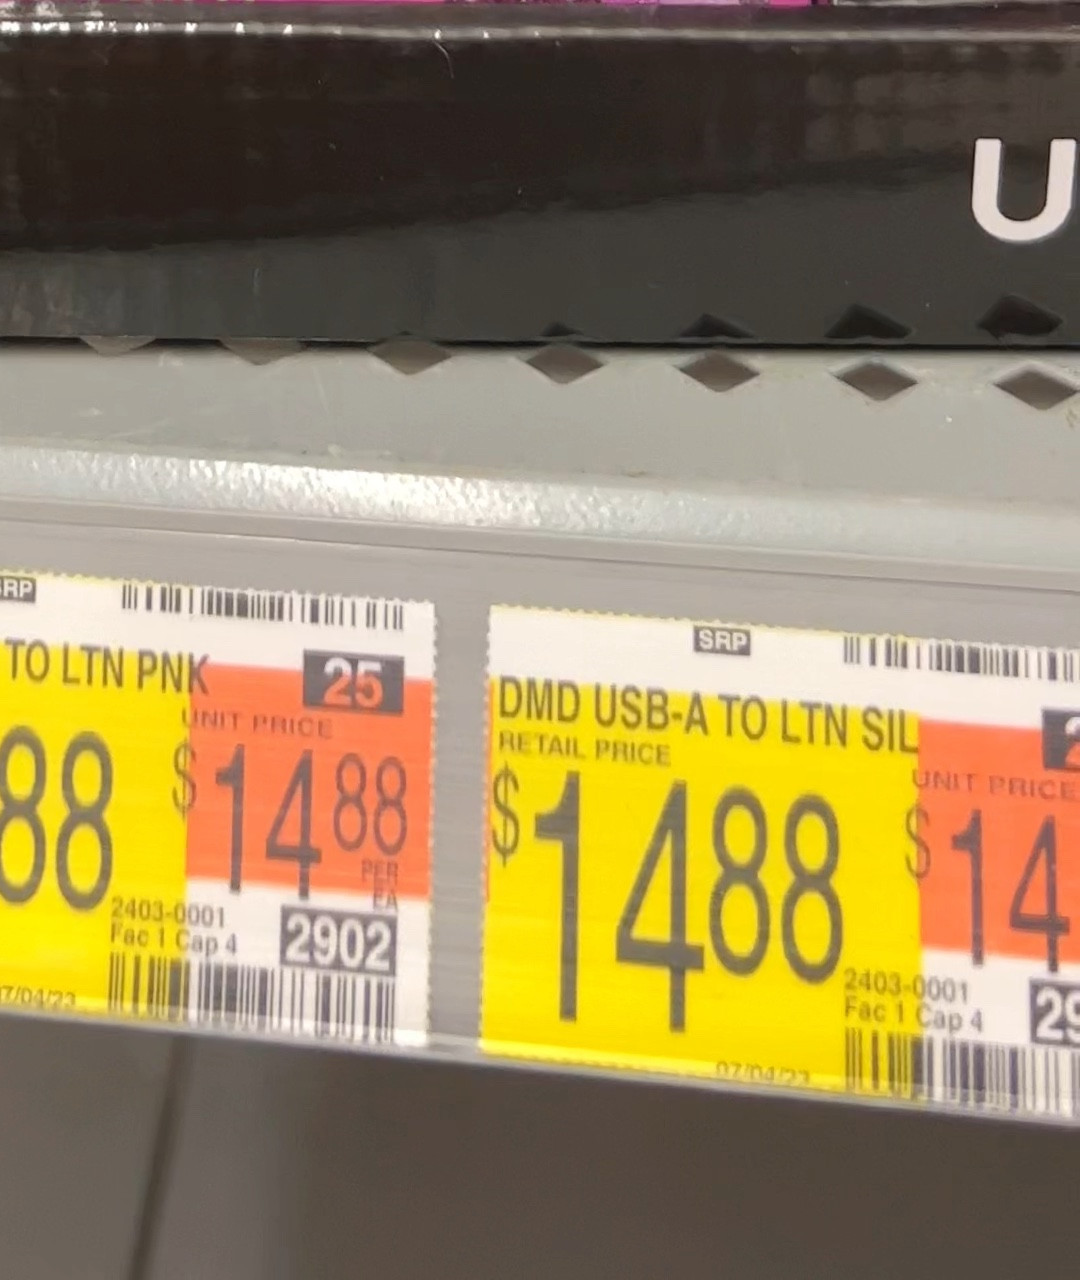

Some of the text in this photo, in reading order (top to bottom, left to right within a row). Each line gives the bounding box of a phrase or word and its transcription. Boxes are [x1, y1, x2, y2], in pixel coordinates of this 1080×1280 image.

[971, 137, 1077, 243] U
[697, 629, 749, 653] SRP
[3, 637, 51, 684] TO
[60, 641, 125, 689] LTN
[136, 647, 211, 696] PNK
[321, 656, 384, 708] 25
[181, 707, 334, 740] UNIT PRICE
[498, 674, 920, 755] DMD USB-A TO LTN SIL
[498, 730, 671, 768] RETAIL PRICE
[911, 767, 1080, 802] UNIT PRICE
[361, 858, 399, 885] PER
[110, 896, 226, 929] 2403-0001
[158, 928, 167, 949] 1
[179, 928, 220, 958] Cap
[224, 934, 238, 955] 4
[284, 912, 393, 973] 2902
[843, 966, 970, 1004] 2403-0001
[844, 995, 984, 1033] Fac 1 Cap 4
